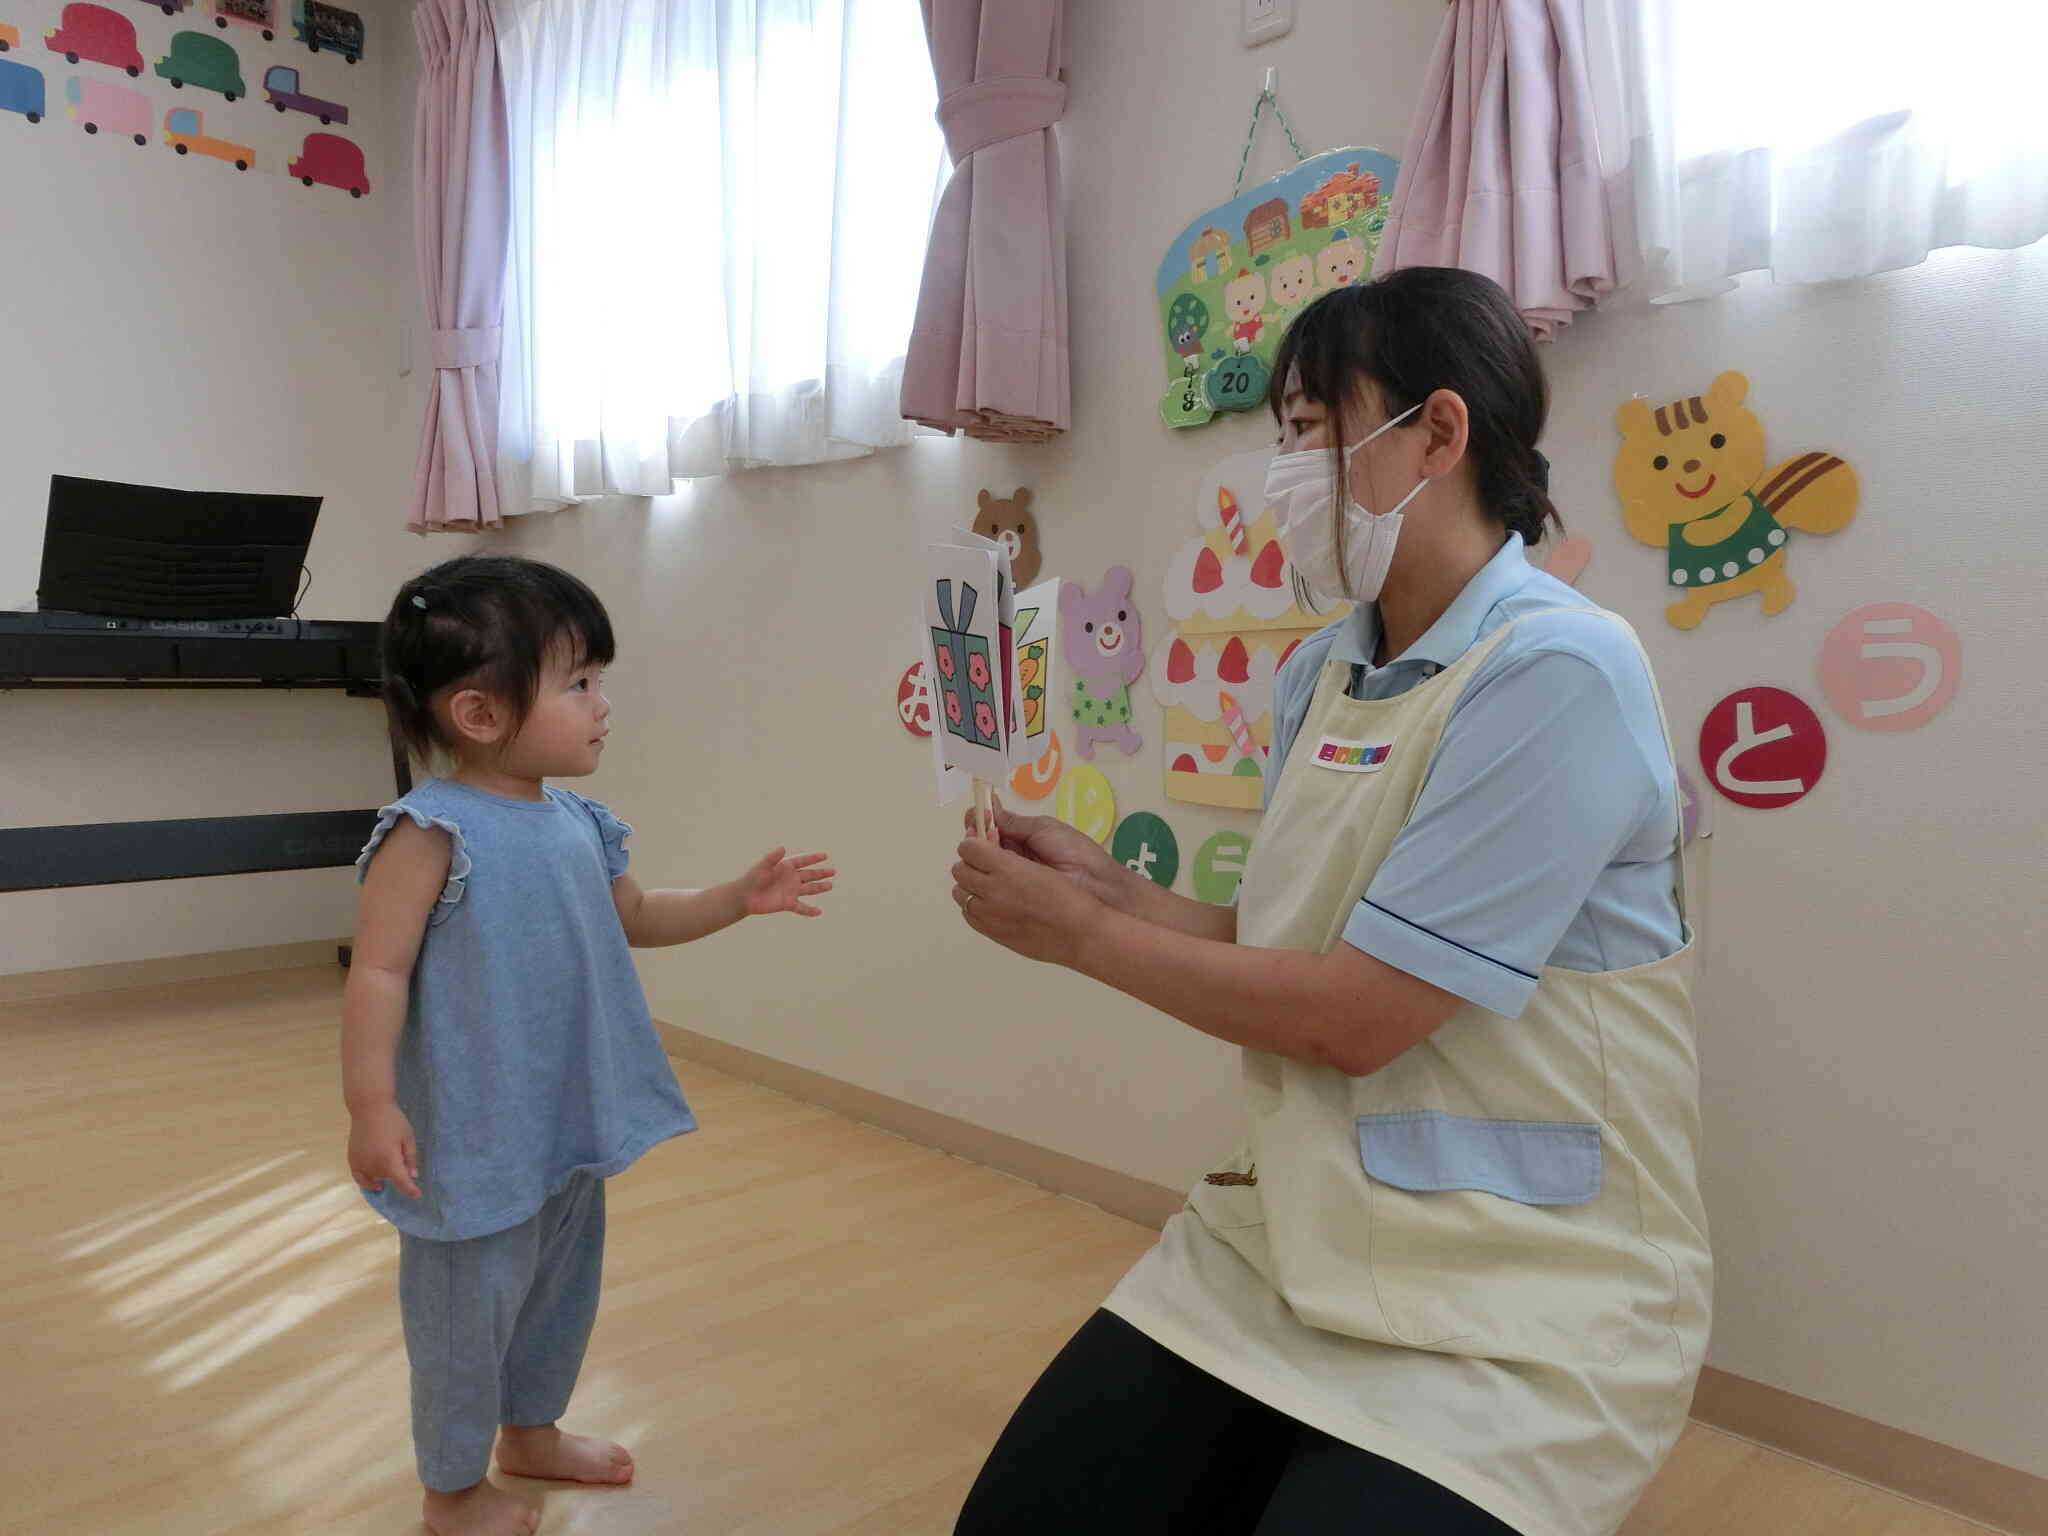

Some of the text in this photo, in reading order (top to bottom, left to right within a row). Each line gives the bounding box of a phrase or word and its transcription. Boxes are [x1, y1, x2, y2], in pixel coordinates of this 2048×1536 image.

[1222, 371, 1250, 393] 20
[1861, 618, 1943, 718] う
[1716, 702, 1804, 794] と
